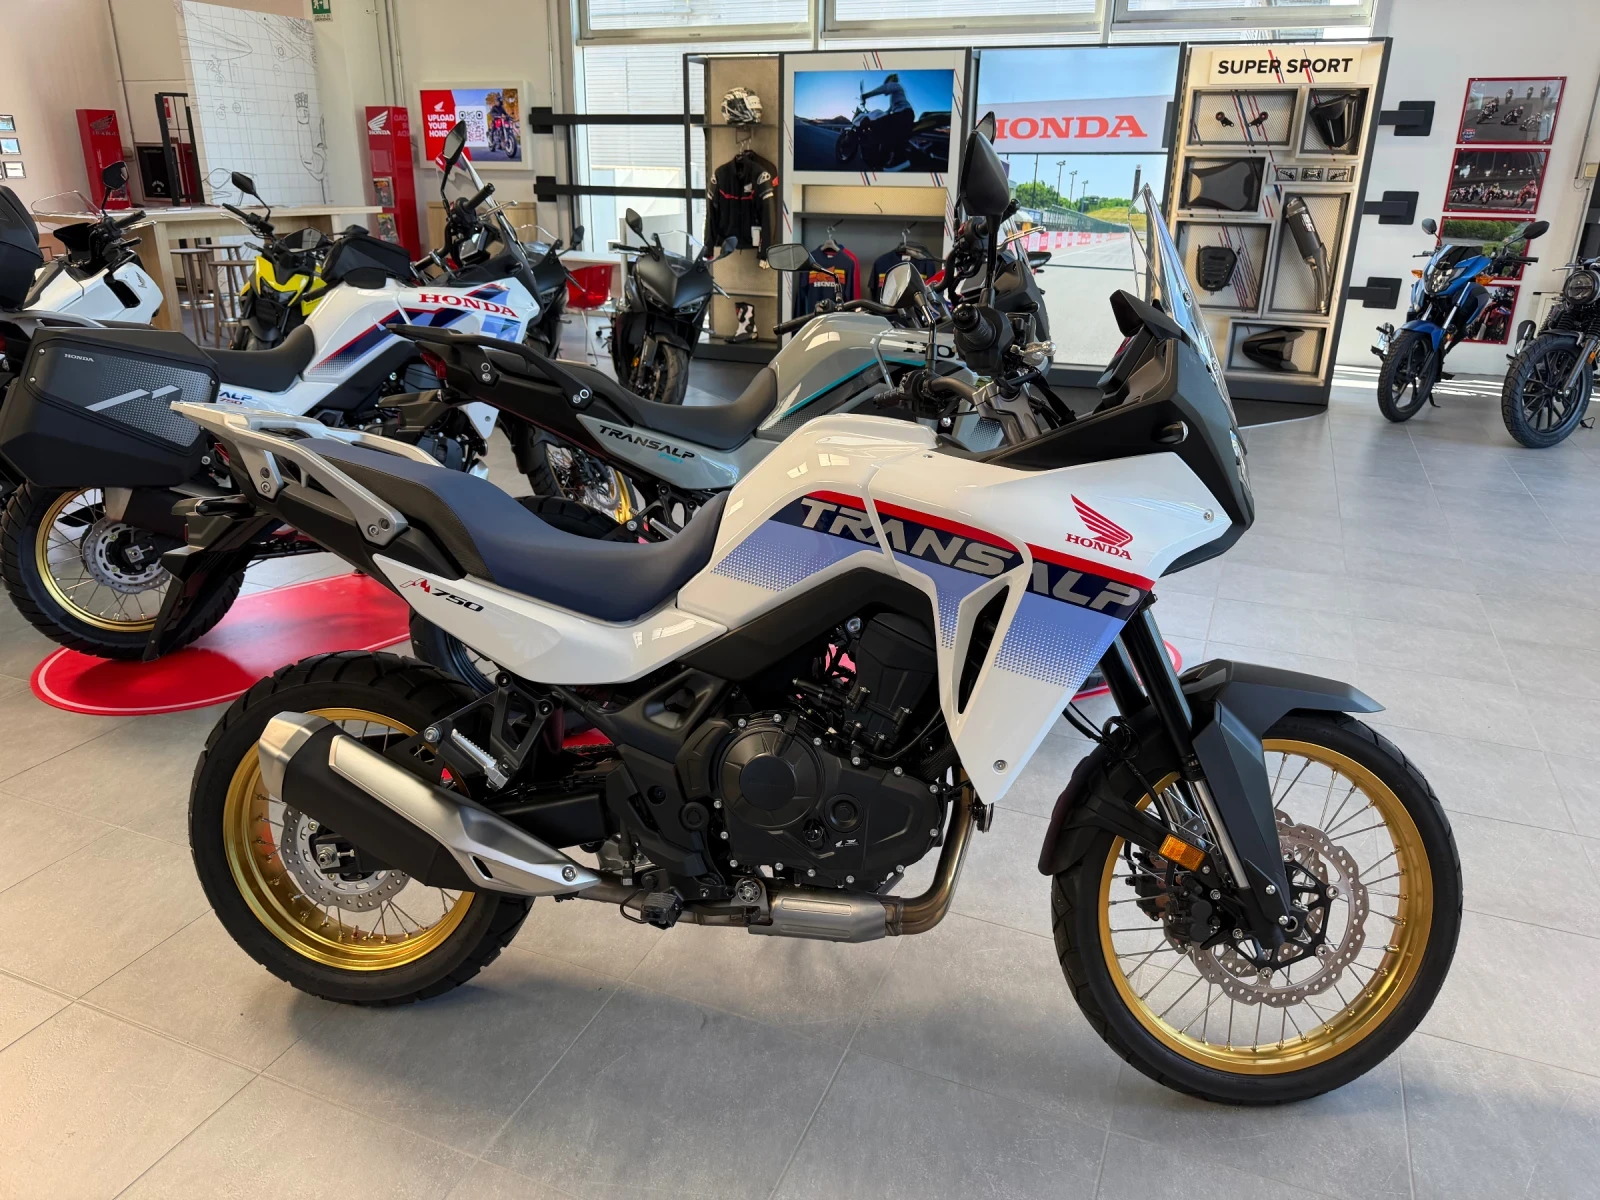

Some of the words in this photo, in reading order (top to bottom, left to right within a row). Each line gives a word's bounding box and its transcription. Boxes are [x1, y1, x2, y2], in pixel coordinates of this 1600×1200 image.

[1217, 60, 1281, 74] SUPER
[1285, 58, 1353, 74] SPORT
[418, 293, 519, 318] HONDA
[64, 353, 95, 362] HONDA
[599, 425, 695, 459] TRANSALP
[800, 498, 1141, 610] TRANSALP
[1065, 532, 1132, 561] HONDA
[431, 588, 484, 612] 750
